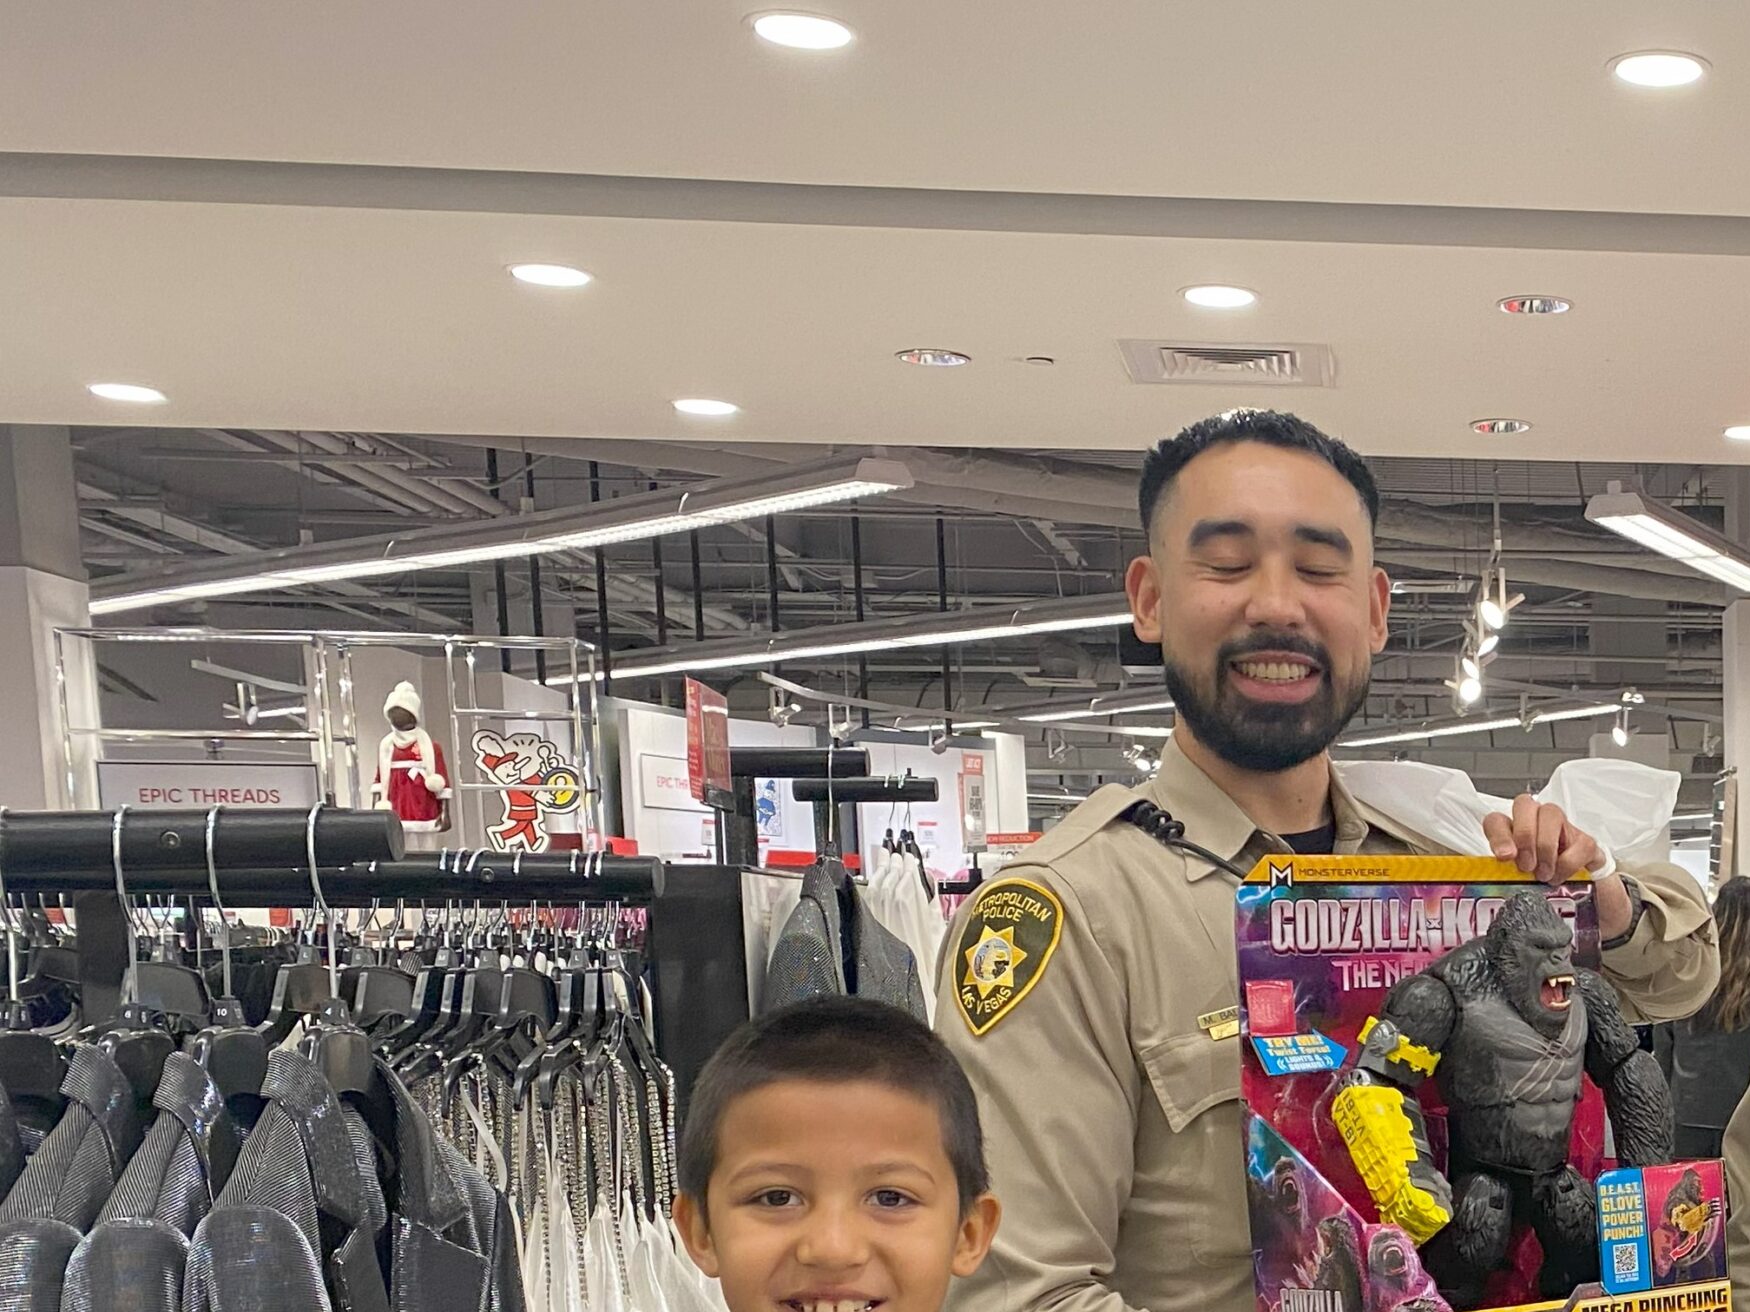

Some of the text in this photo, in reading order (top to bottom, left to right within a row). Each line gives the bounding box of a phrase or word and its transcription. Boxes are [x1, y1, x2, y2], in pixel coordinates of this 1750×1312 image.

[656, 776, 673, 788] EPIC
[139, 788, 280, 803] EPIC THREADS
[1299, 867, 1391, 878] MONSTERVERSE
[983, 906, 1024, 922] POLICE
[1270, 899, 1430, 956] GODZILLA
[1331, 960, 1381, 991] THE
[976, 986, 1012, 1015] VEGAS
[217, 1008, 227, 1017] 10
[1203, 1015, 1214, 1025] M.
[1263, 1037, 1292, 1047] TRY
[1602, 1195, 1642, 1212] GLOVE
[1602, 1211, 1643, 1227] POWER
[1603, 1225, 1644, 1241] PUNCH!
